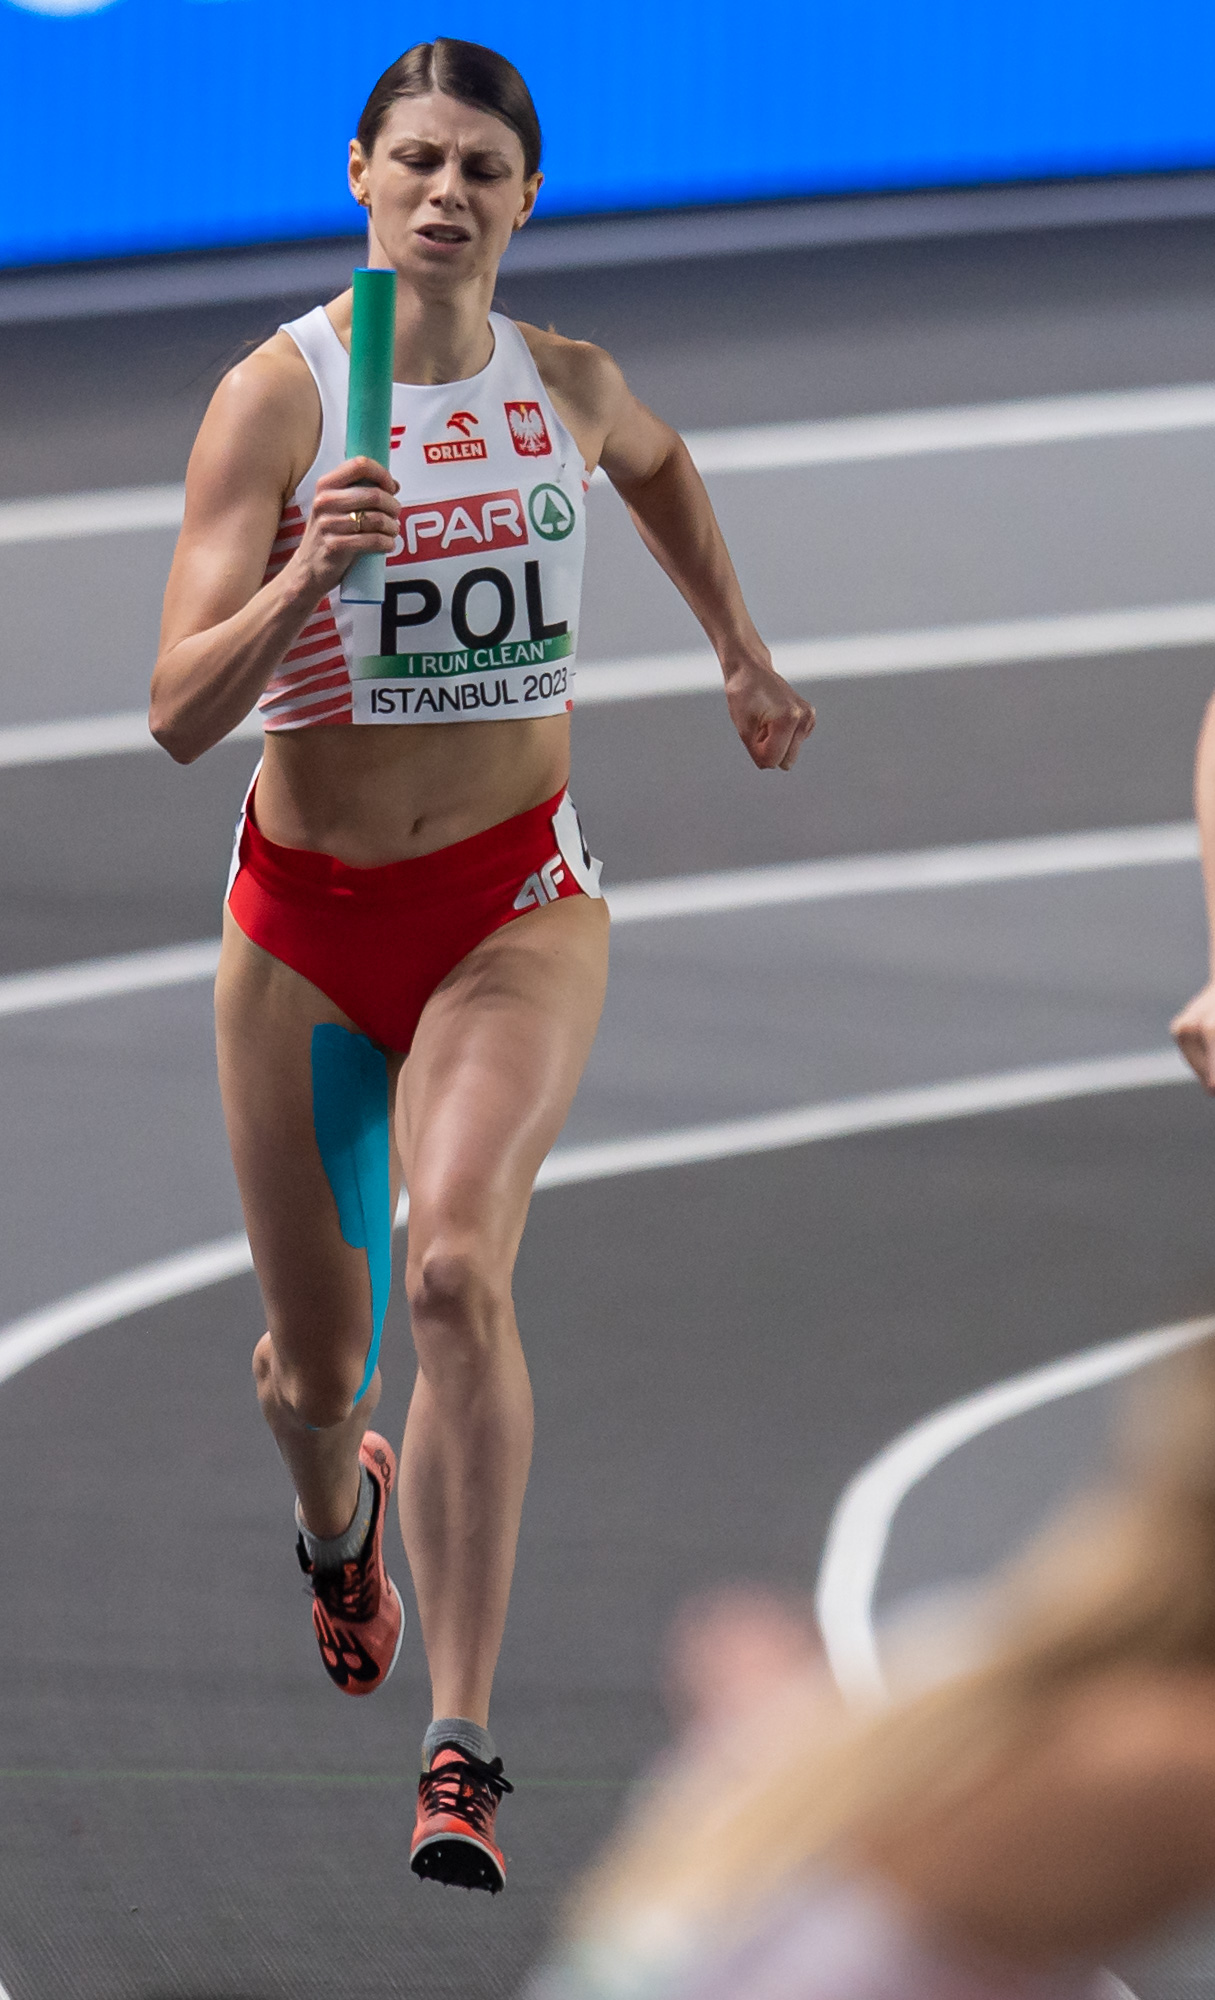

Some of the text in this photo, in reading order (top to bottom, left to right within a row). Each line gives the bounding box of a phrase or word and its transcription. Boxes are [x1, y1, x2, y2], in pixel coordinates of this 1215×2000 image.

[427, 442, 484, 461] ORLEN
[380, 560, 568, 656] POL
[408, 656, 414, 674] I
[422, 655, 468, 674] RUN
[371, 667, 568, 714] ISTANBUL 2023
[513, 854, 565, 911] 4F
